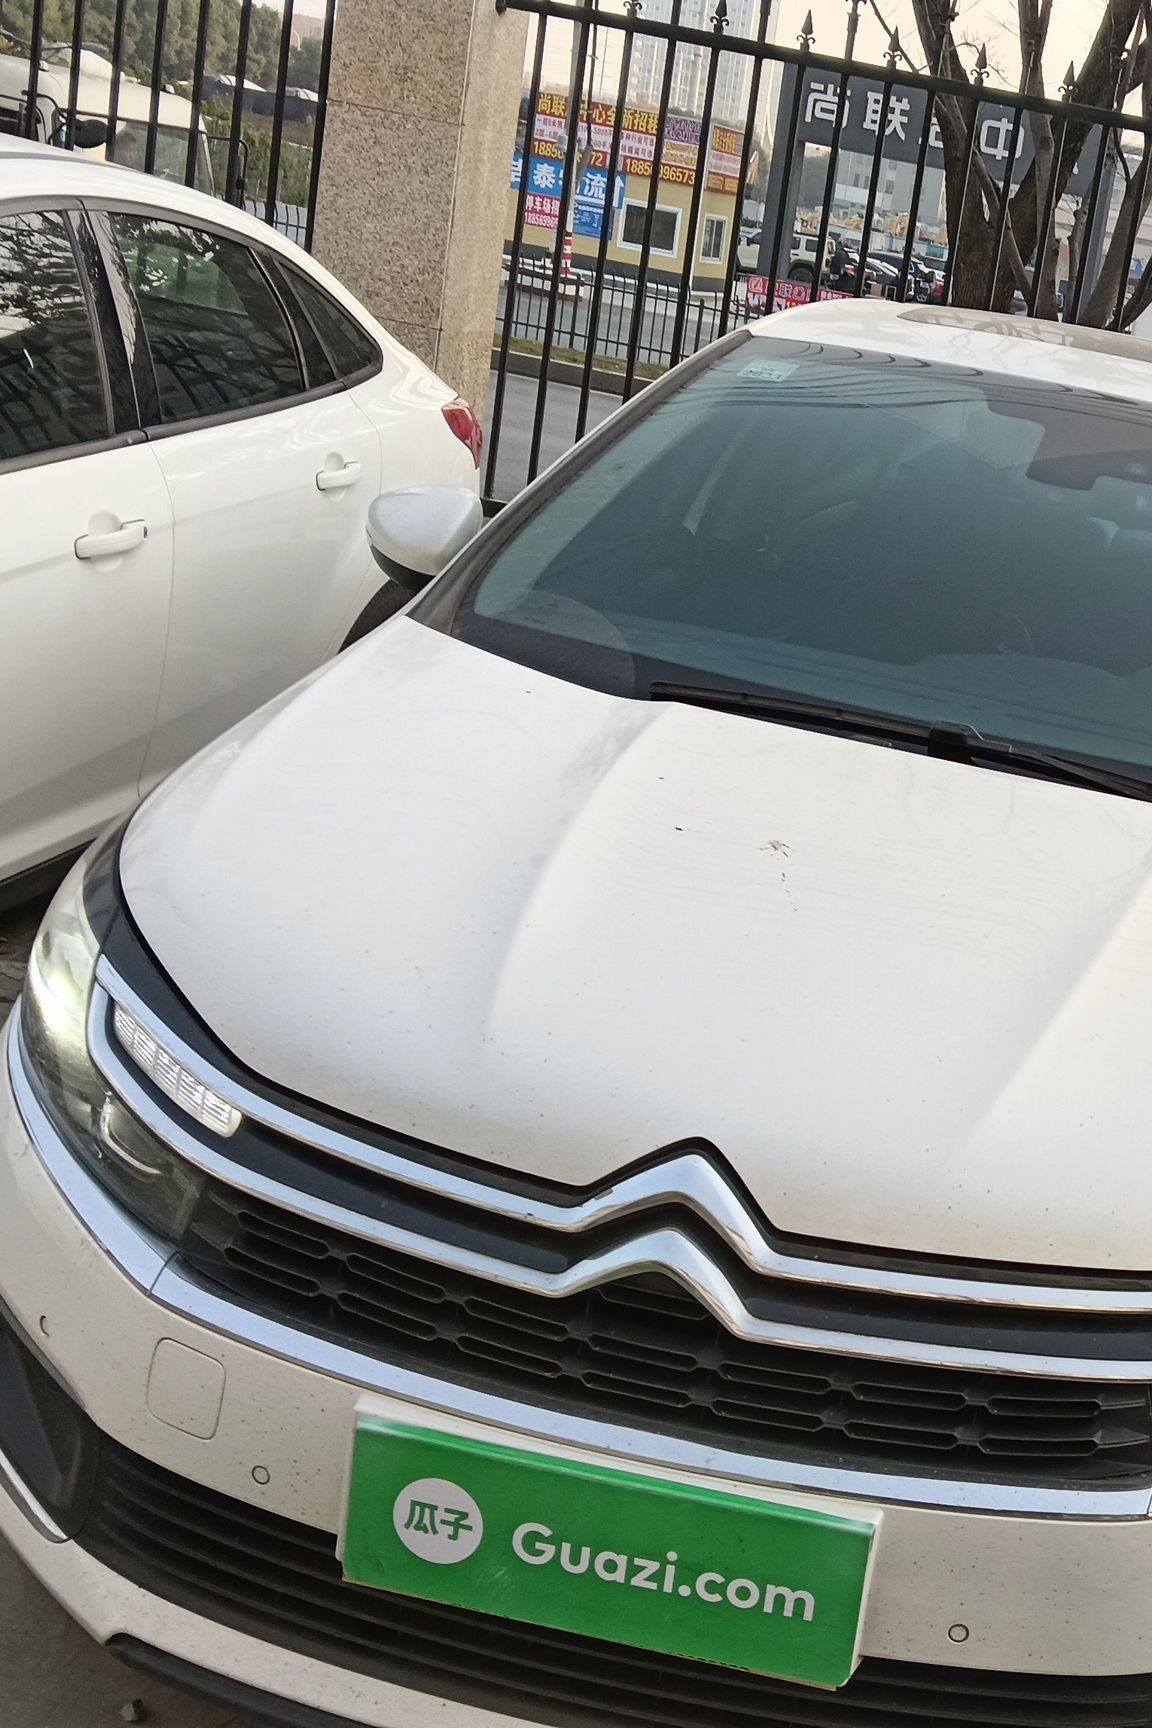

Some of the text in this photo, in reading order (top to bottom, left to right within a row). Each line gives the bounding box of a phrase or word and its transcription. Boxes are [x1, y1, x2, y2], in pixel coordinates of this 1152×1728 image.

[538, 93, 659, 134] 尚联中心全新招租
[511, 158, 607, 198] 泰流
[626, 158, 695, 185] 188596573
[404, 1500, 473, 1541] 瓜子
[512, 1522, 815, 1622] Guazi.com
